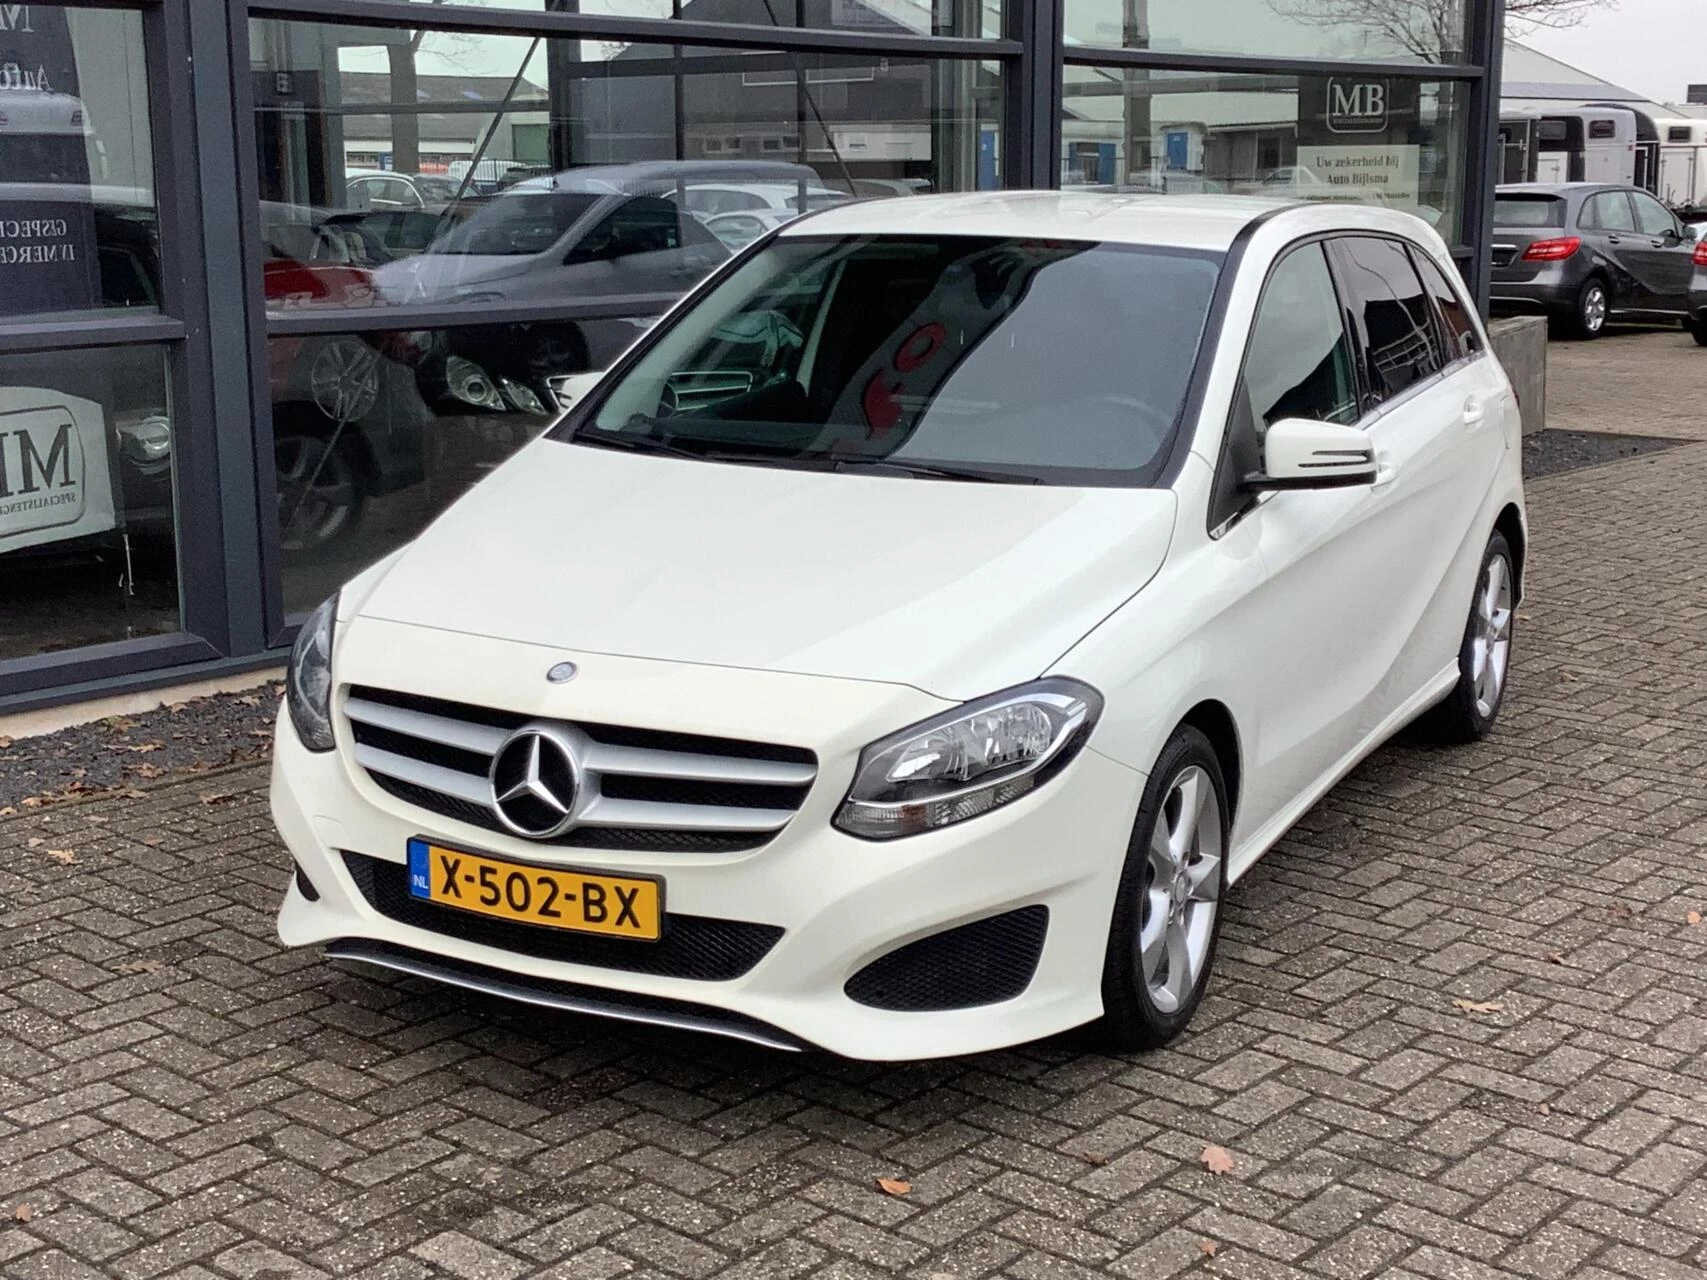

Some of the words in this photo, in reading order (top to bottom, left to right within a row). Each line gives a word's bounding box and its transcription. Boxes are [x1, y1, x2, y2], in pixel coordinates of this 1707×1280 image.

[1332, 83, 1385, 117] MB
[1316, 156, 1332, 168] Uw
[1335, 155, 1384, 168] zekerheid
[1386, 155, 1399, 169] bij
[1327, 173, 1350, 185] Auto
[1352, 173, 1389, 186] Bijlsma
[413, 874, 429, 890] NL
[440, 854, 641, 930] X-502-BX
